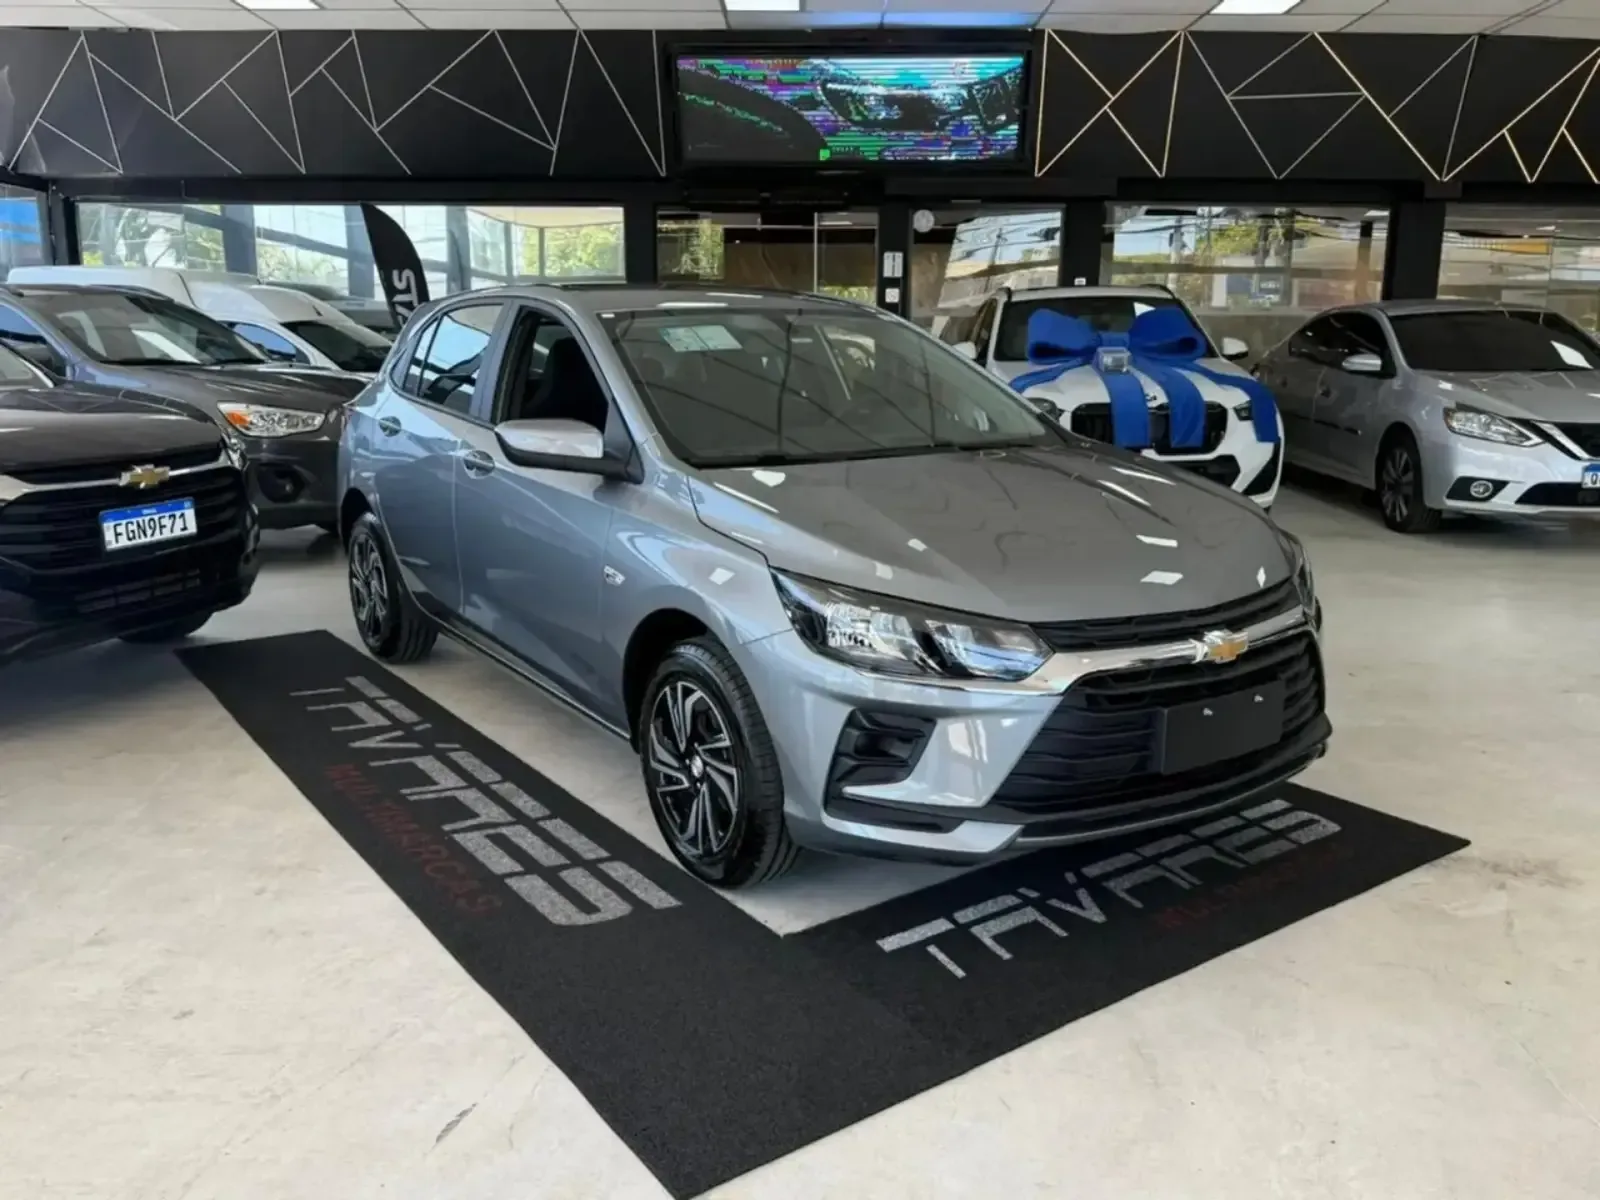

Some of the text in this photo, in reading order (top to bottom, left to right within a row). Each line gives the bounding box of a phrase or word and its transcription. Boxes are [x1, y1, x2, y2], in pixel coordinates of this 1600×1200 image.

[113, 512, 188, 544] FGN9F71
[290, 676, 682, 927] TAVARES
[876, 799, 1342, 979] TAVARES
